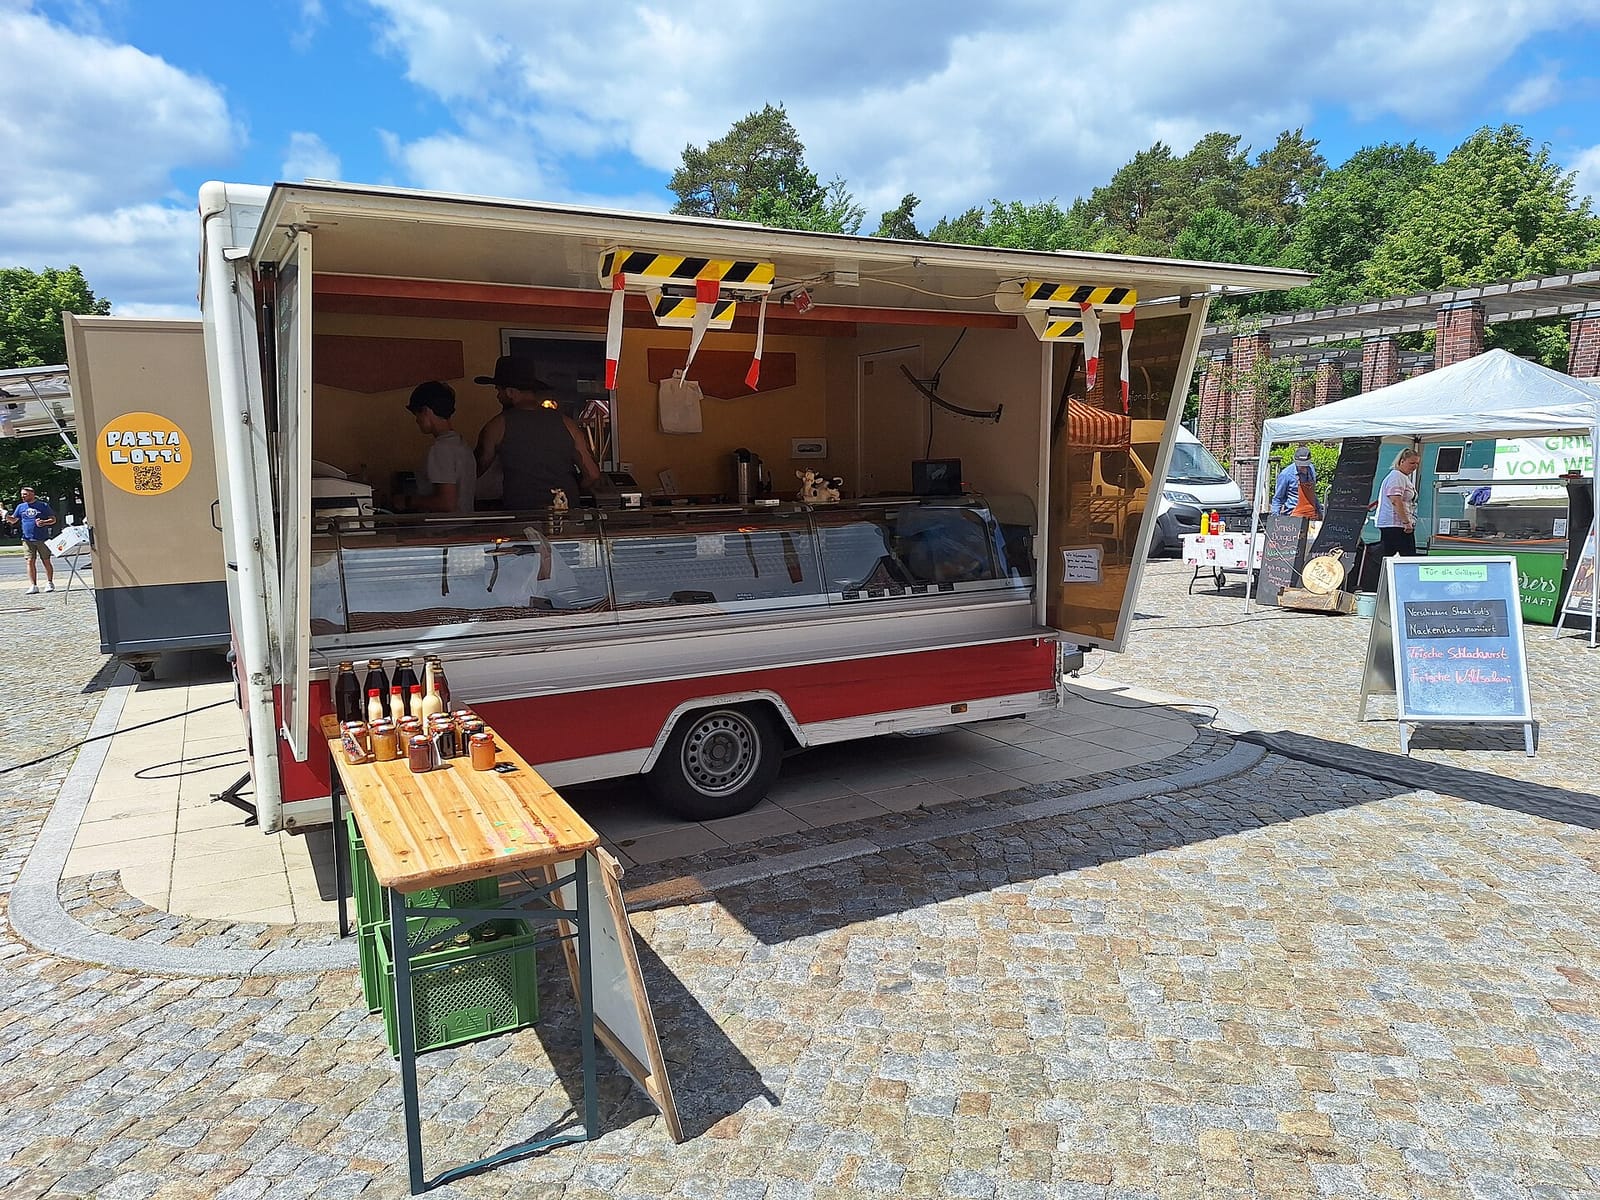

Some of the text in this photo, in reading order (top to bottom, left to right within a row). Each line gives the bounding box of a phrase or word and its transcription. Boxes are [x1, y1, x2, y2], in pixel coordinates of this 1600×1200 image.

[107, 431, 180, 446] PASTA
[1506, 458, 1555, 476] VOM
[1409, 623, 1461, 636] Nackensteak
[1411, 667, 1450, 683] Frische
